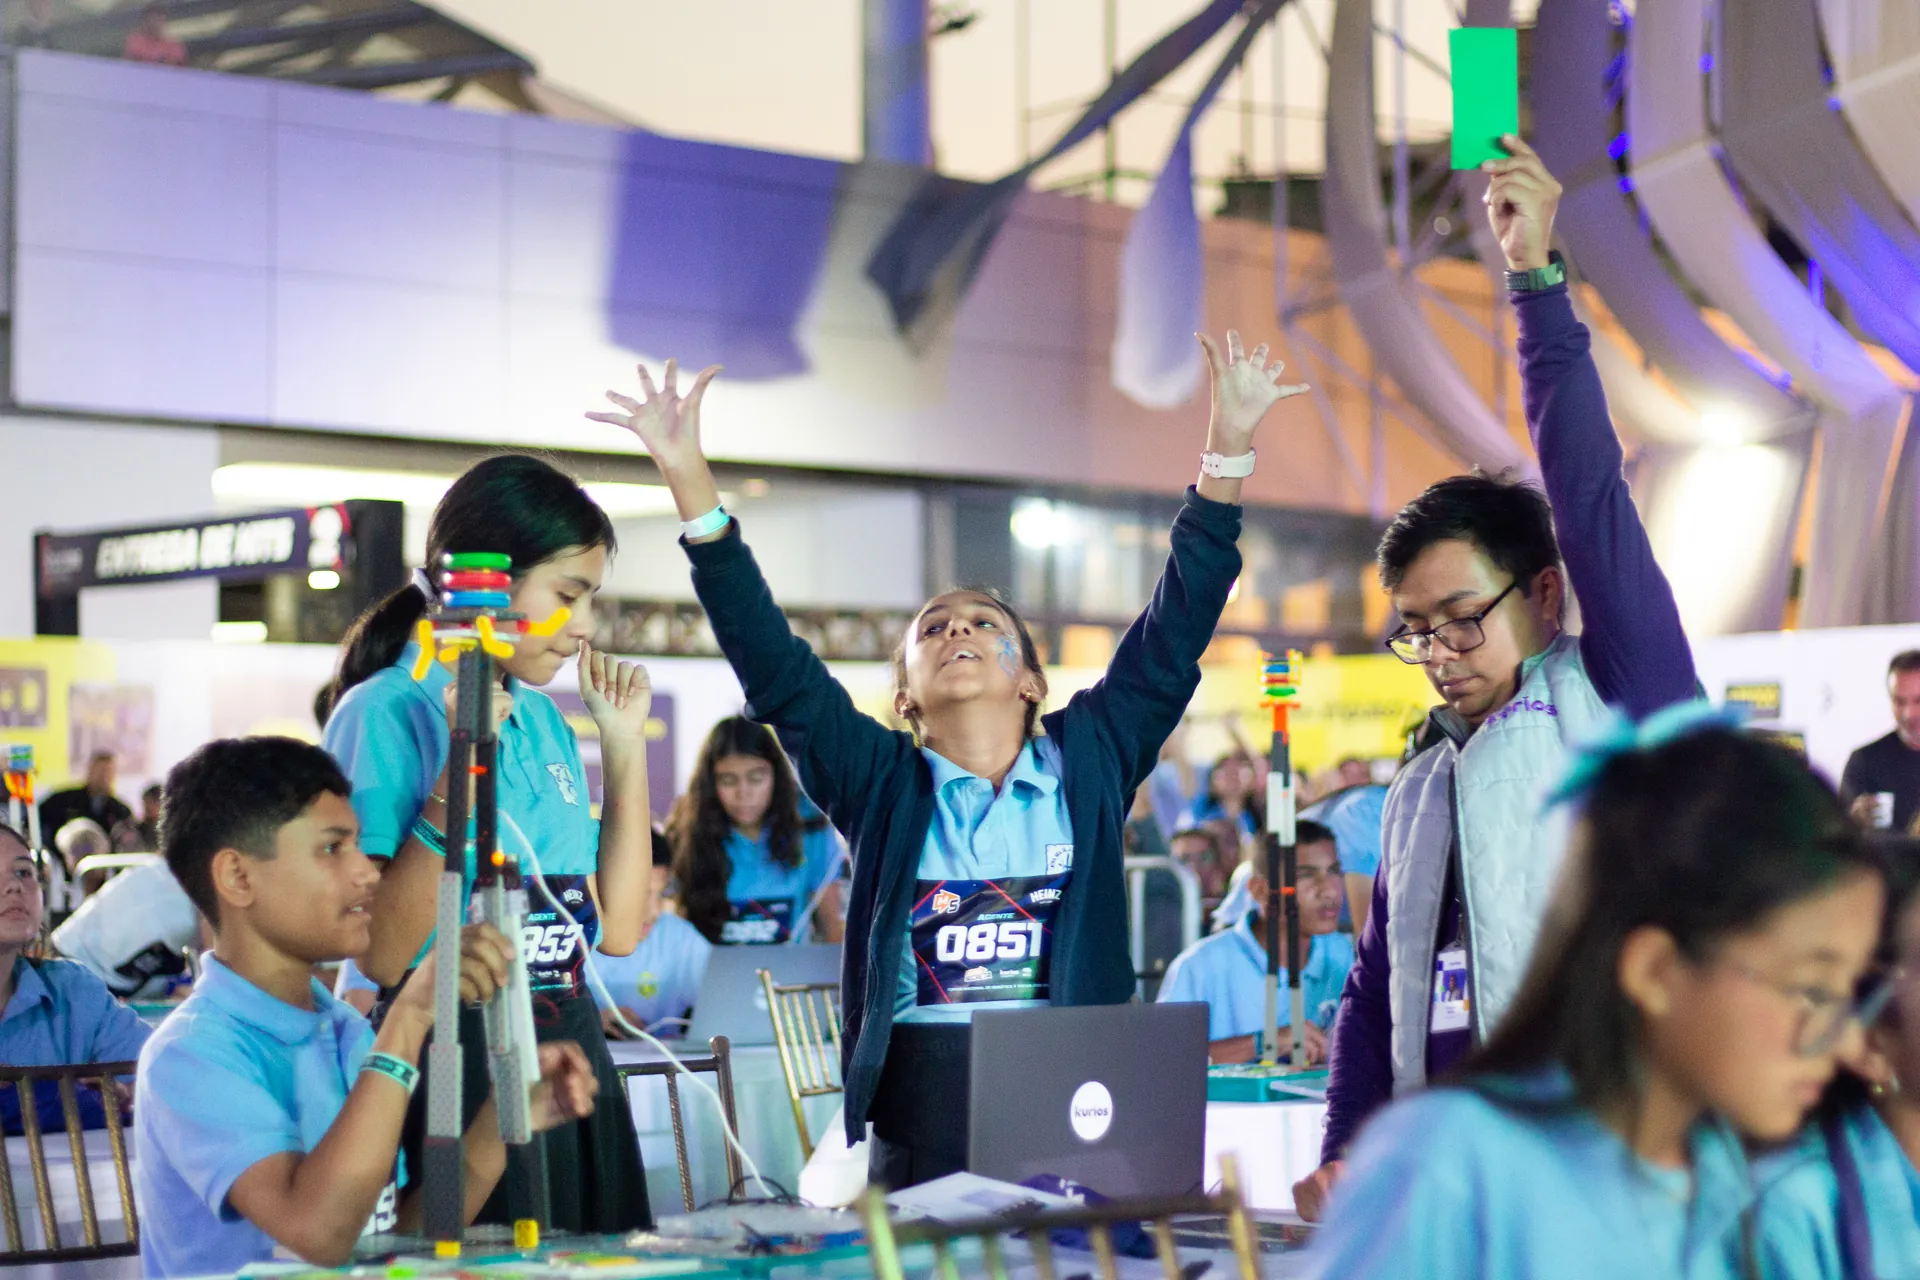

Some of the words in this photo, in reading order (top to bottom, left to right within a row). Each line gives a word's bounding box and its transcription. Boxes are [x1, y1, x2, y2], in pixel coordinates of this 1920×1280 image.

[563, 888, 585, 902] HEINZ
[1029, 888, 1063, 904] HEINZ
[527, 912, 558, 921] AGENTE
[976, 912, 1016, 921] AGENTE
[936, 922, 1043, 962] 0851
[1074, 1105, 1109, 1118] kurios
